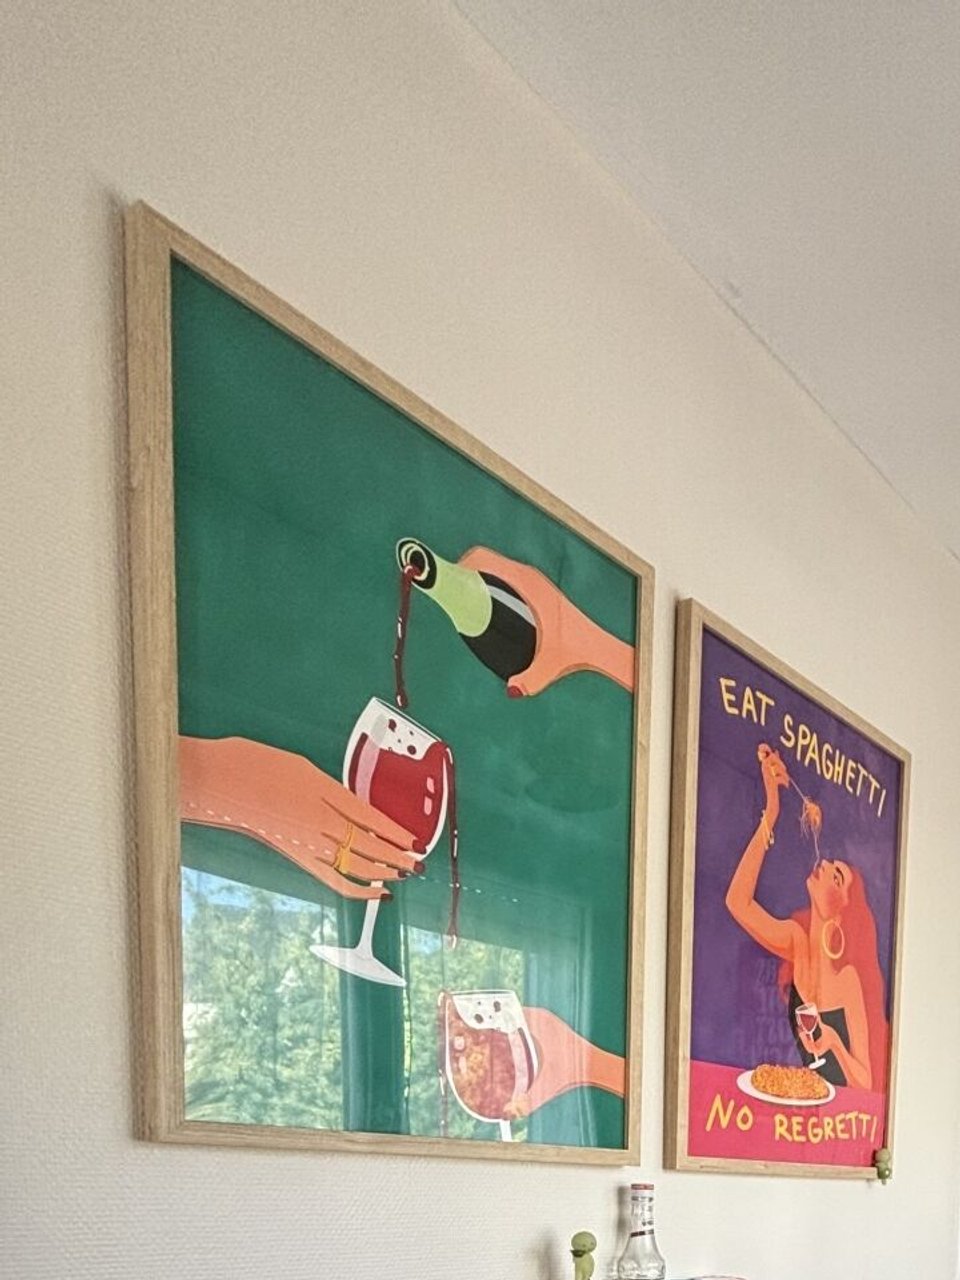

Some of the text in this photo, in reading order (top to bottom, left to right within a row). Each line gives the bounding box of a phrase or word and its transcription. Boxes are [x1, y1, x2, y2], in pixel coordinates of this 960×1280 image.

[719, 677, 886, 818] EAT SPAGHETTI
[705, 1094, 878, 1144] NO REGRETTI
